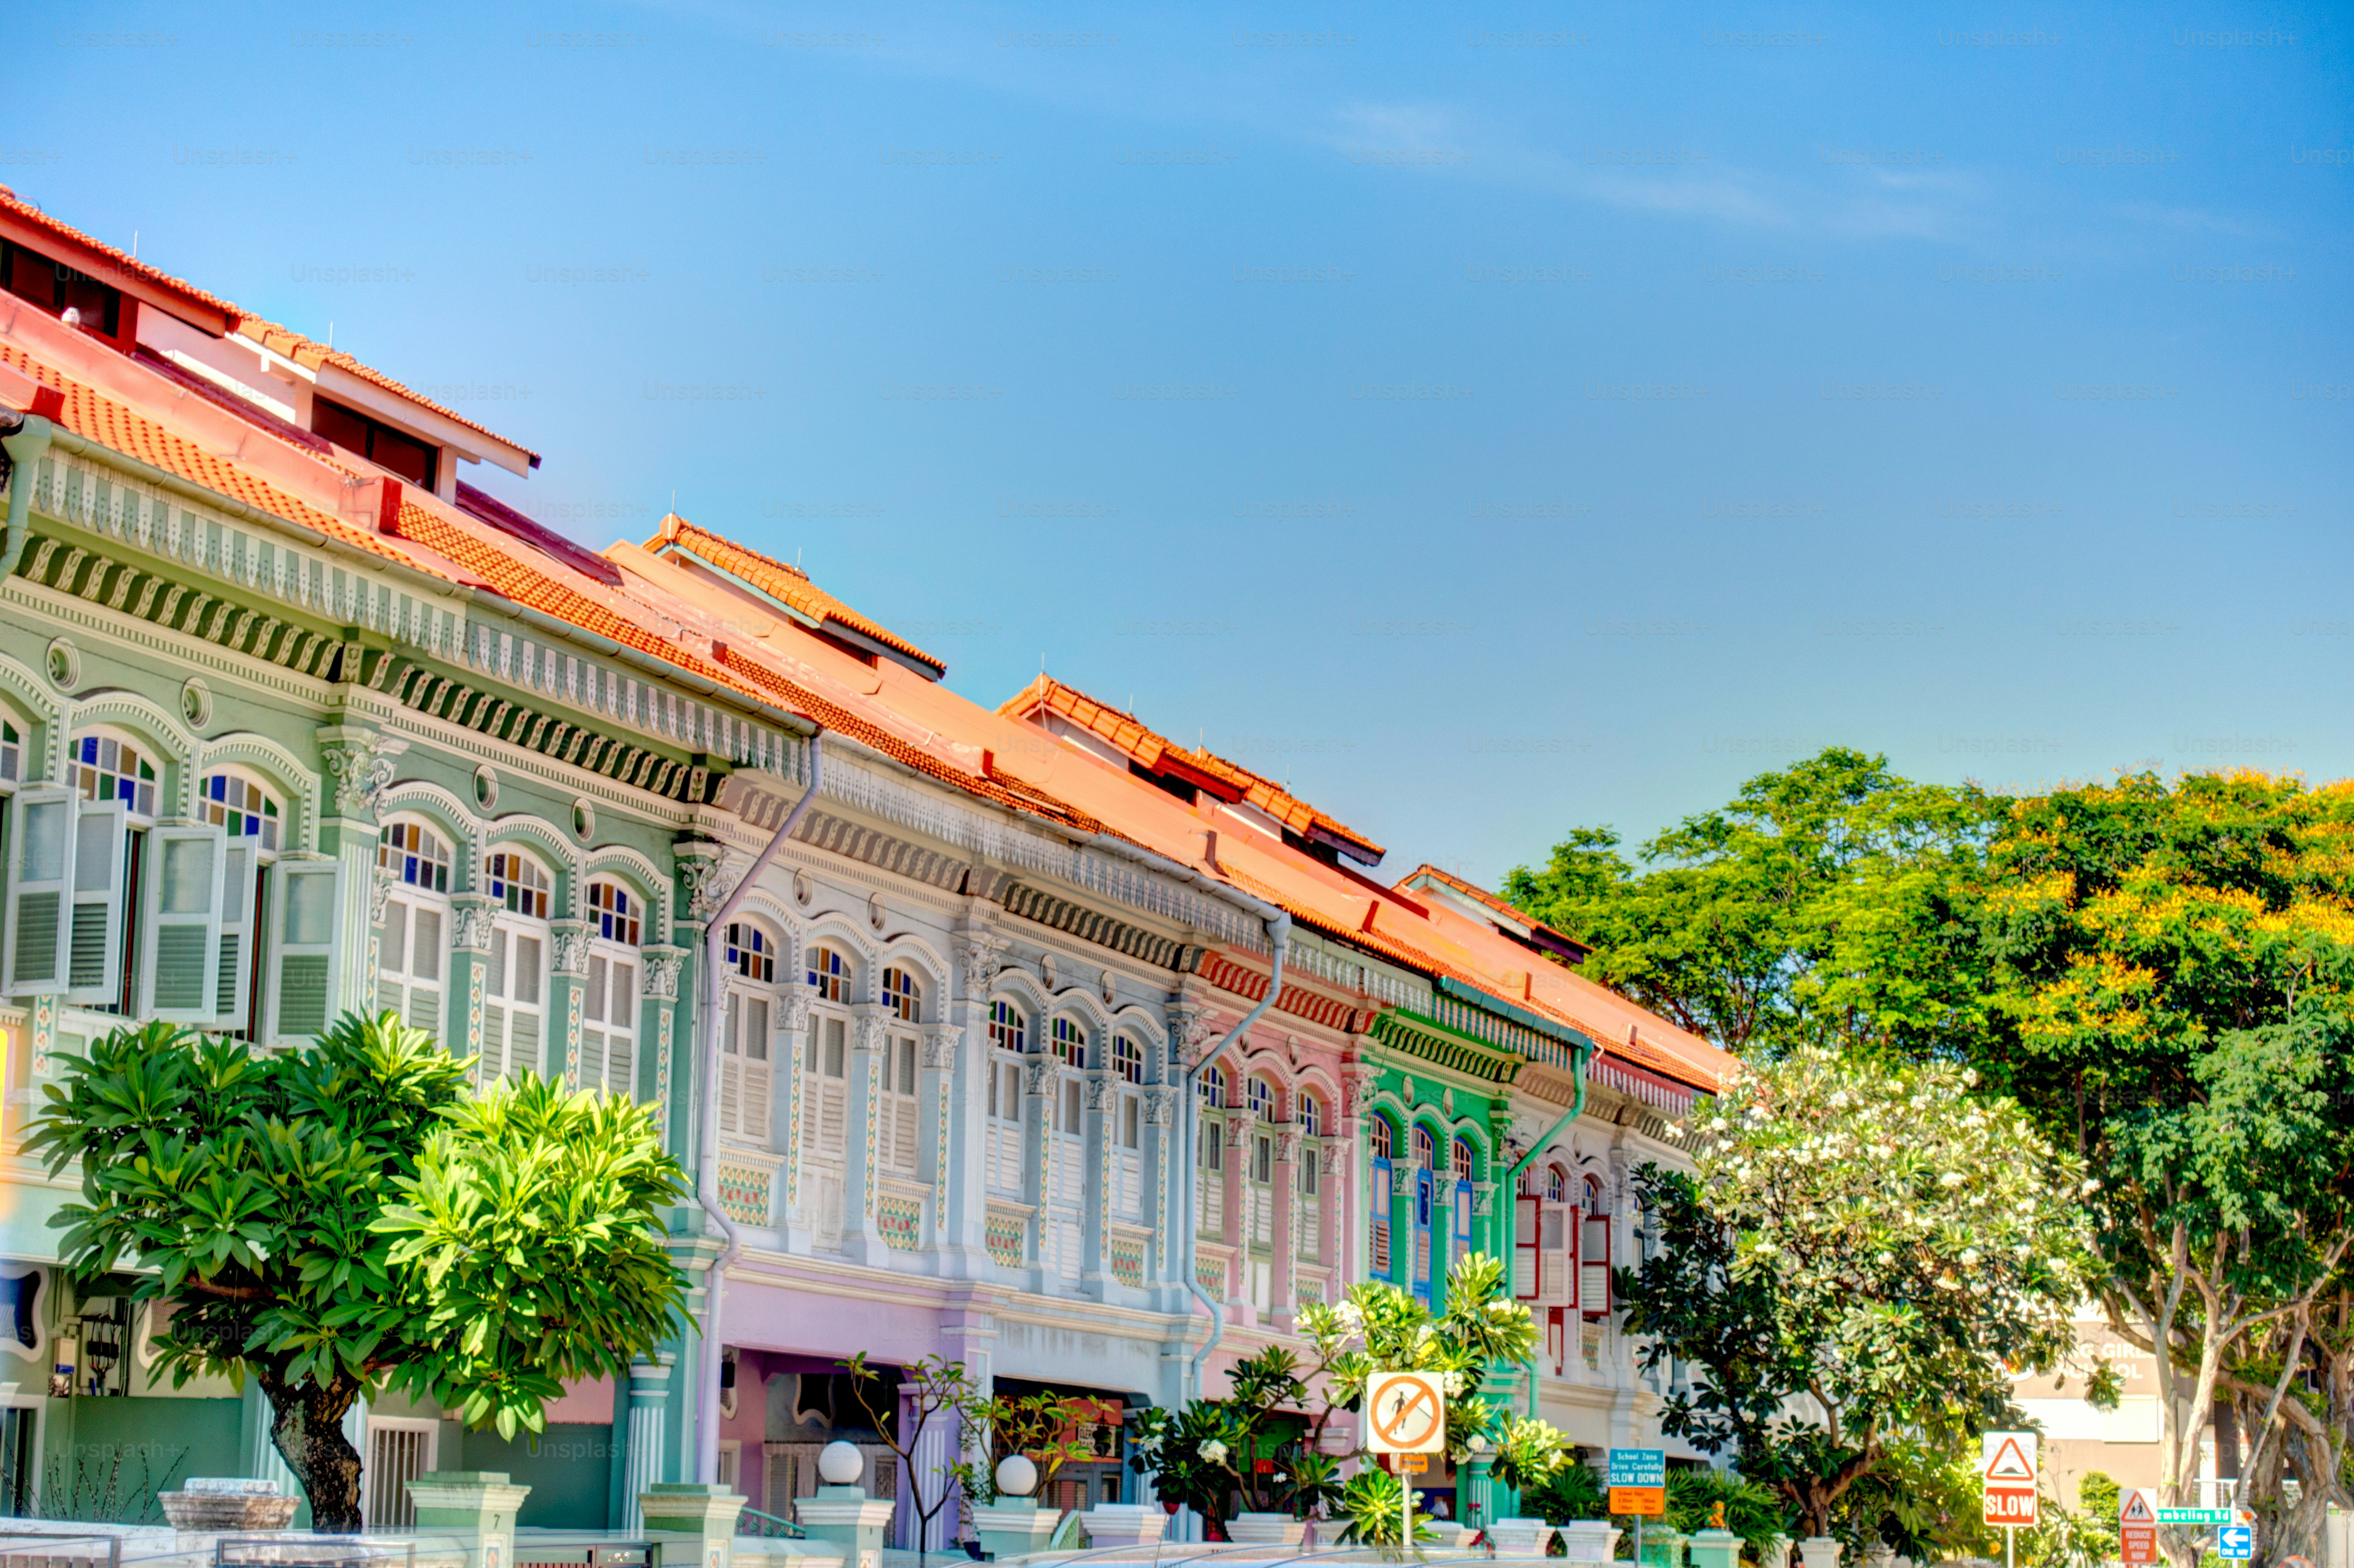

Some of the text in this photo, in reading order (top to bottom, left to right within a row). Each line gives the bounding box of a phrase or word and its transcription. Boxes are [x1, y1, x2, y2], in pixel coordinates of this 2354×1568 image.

[2058, 1364, 2143, 1379] SCHOL
[1617, 1452, 1638, 1460] School
[1632, 1463, 1662, 1472] Carefully
[1611, 1473, 1663, 1483] SLOW DOWN
[1986, 1494, 2034, 1517] SLOW
[2215, 1511, 2228, 1520] Rd
[494, 1514, 501, 1529] 7
[2126, 1530, 2152, 1539] REDUCE
[2128, 1541, 2150, 1549] SPEED
[2131, 1551, 2147, 1560] NOW
